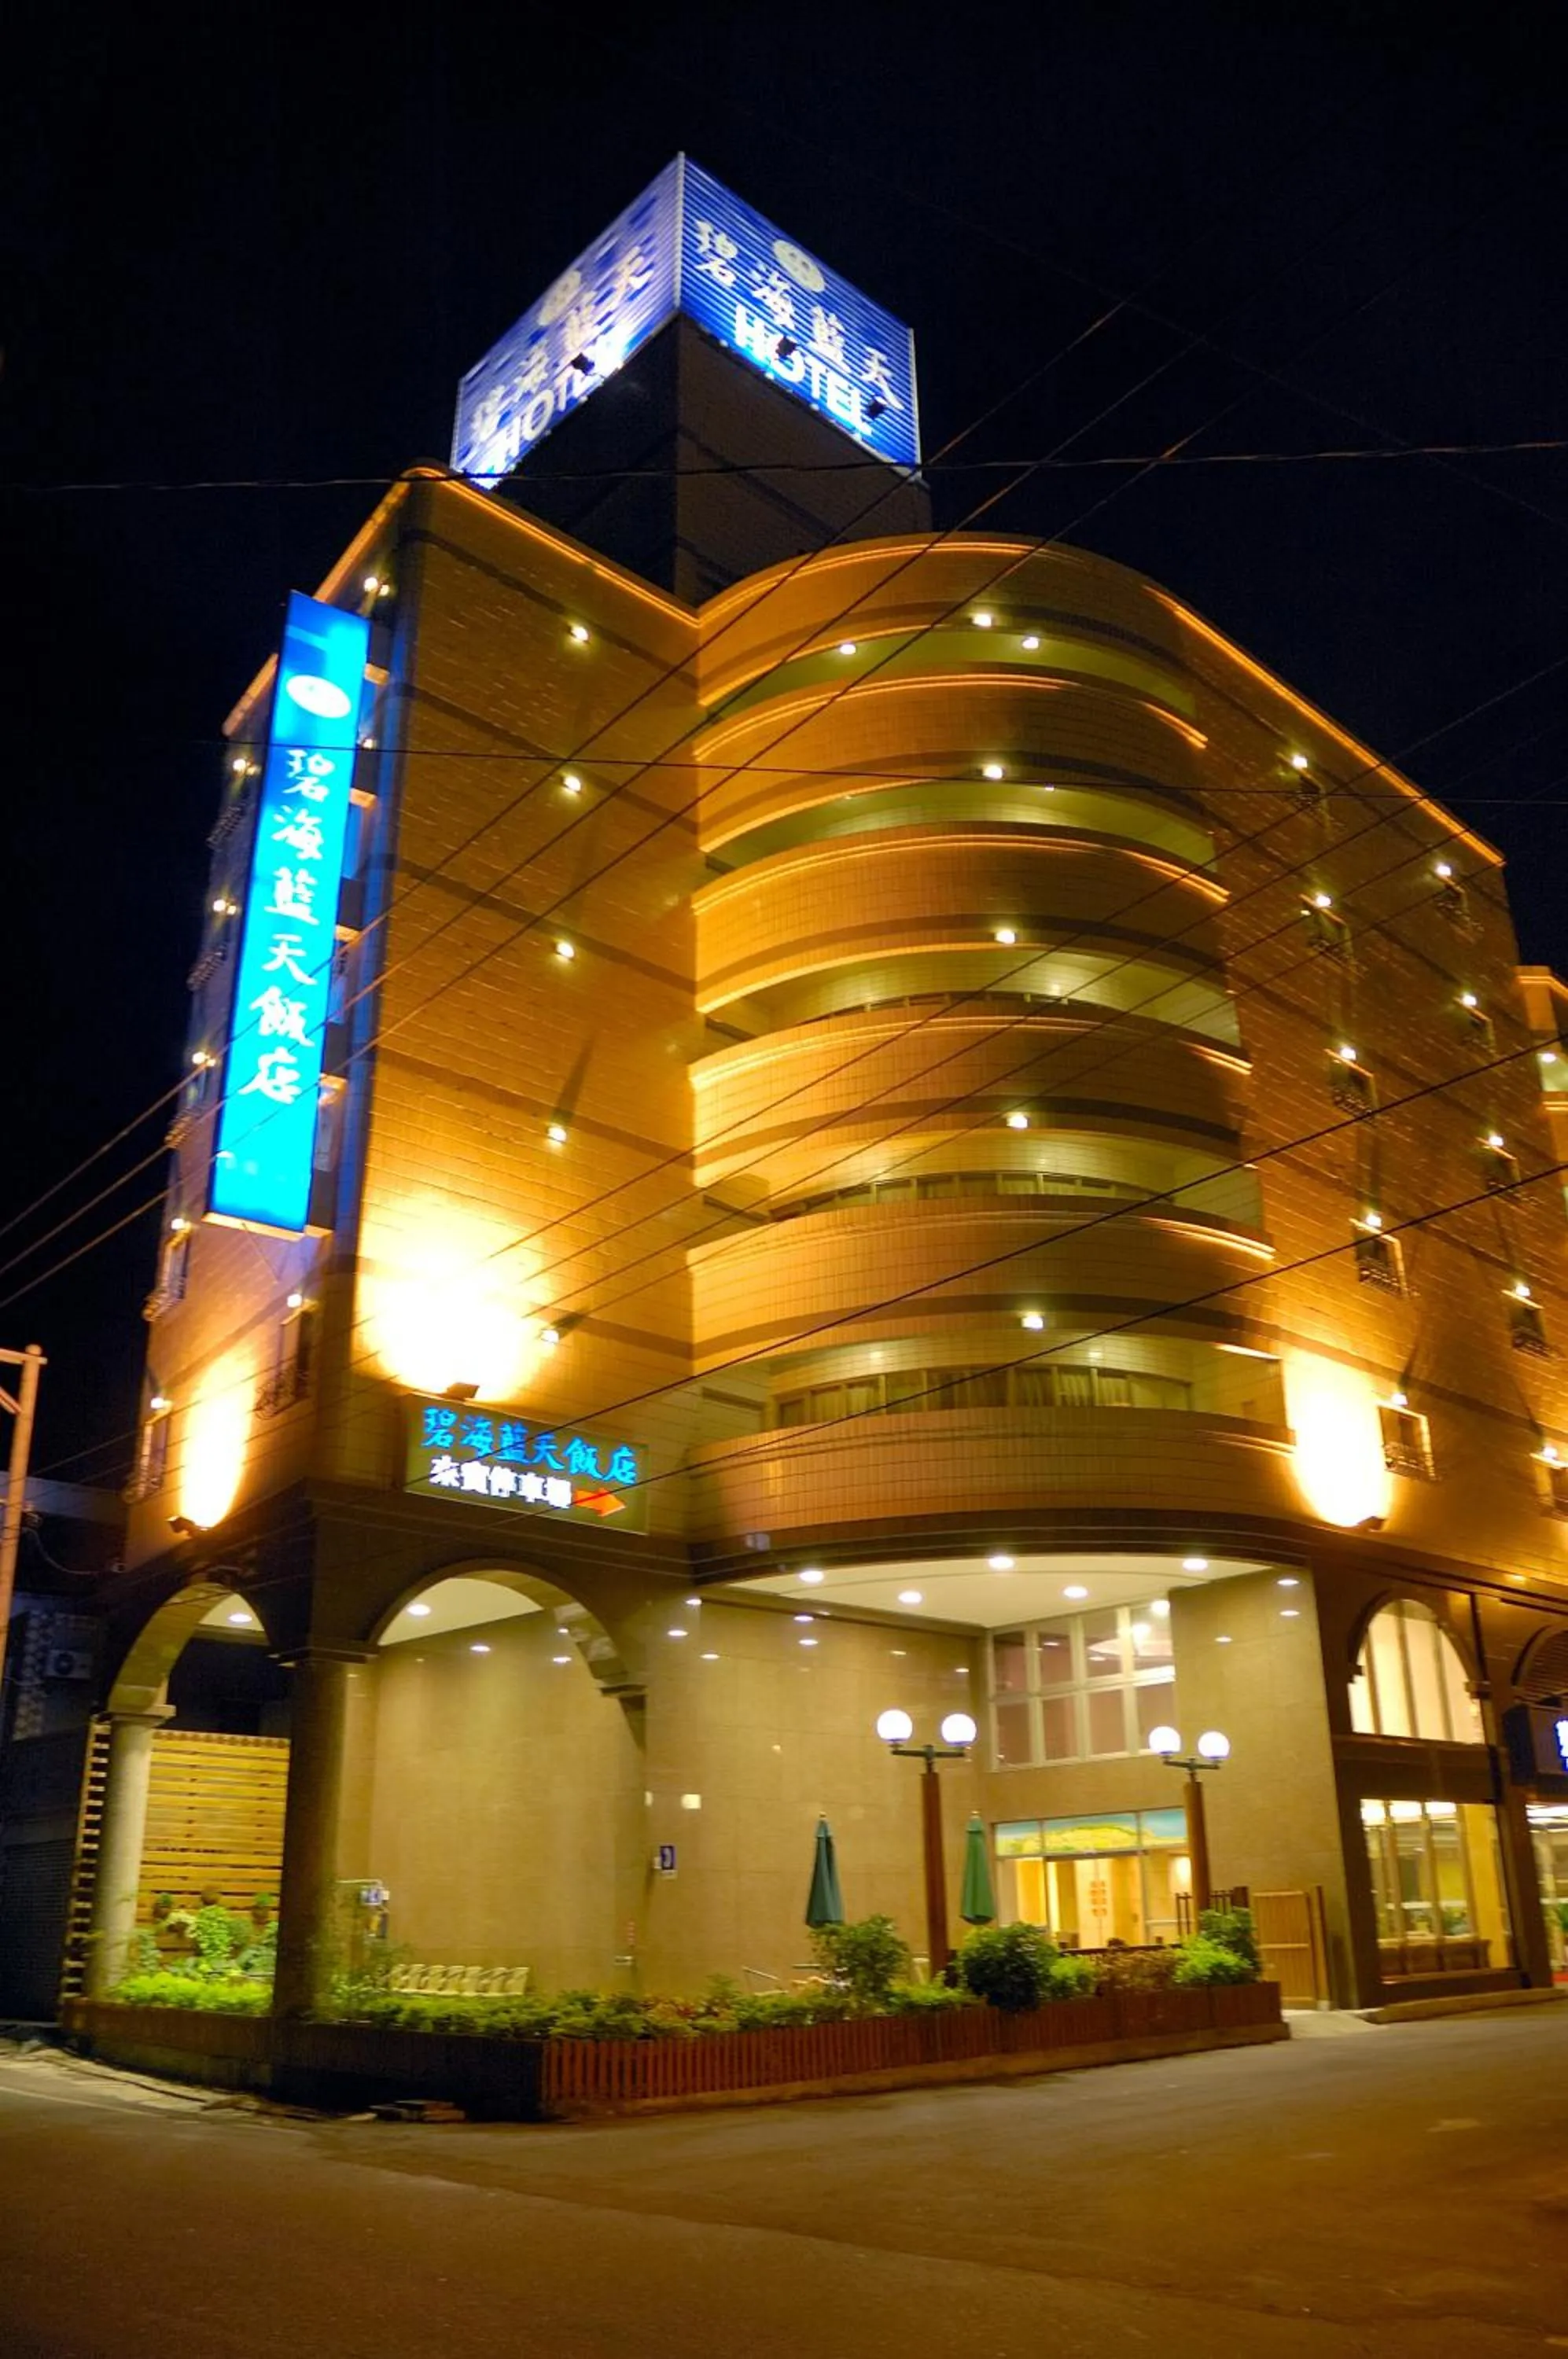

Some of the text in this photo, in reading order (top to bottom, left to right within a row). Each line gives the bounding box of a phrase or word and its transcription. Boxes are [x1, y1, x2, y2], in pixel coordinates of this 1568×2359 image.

[696, 219, 904, 410] 碧海藍天
[735, 304, 873, 436] HOTEL
[238, 749, 336, 1105] 碧海藍天飯店
[421, 1406, 638, 1485] 碧海藍天飯店
